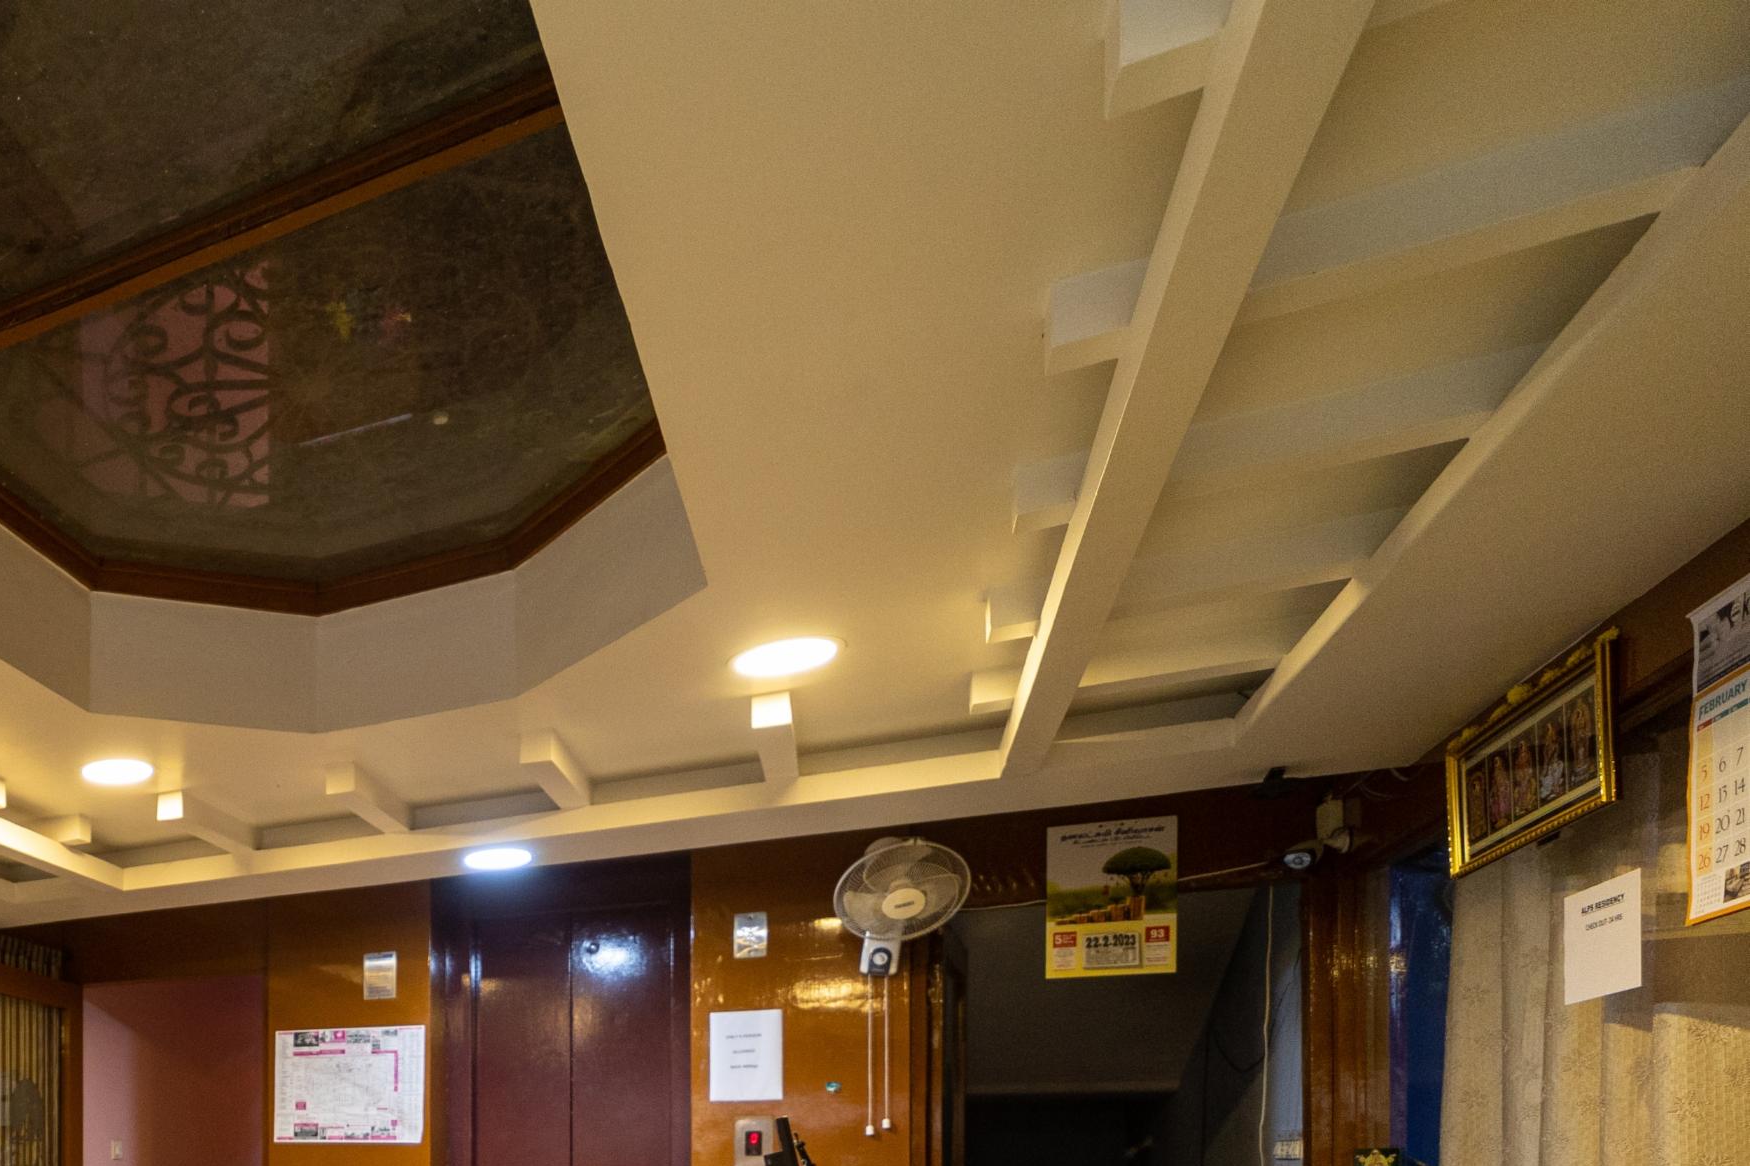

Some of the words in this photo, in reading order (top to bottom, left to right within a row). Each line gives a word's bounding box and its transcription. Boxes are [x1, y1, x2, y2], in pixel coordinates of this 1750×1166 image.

[1699, 680, 1748, 720] FEBRUARY
[1719, 758, 1727, 773] 6
[1736, 747, 1744, 765] 7
[1700, 793, 1710, 811] 12
[1734, 777, 1745, 795] 14
[1699, 823, 1710, 841] 19
[1715, 815, 1730, 835] 20
[1735, 808, 1745, 826] 21
[1698, 854, 1710, 871] 26
[1715, 844, 1729, 864] 27
[1734, 837, 1746, 857] 28
[1594, 893, 1625, 909] RESIDENCY
[1054, 934, 1062, 944] 5
[1150, 929, 1165, 938] 93
